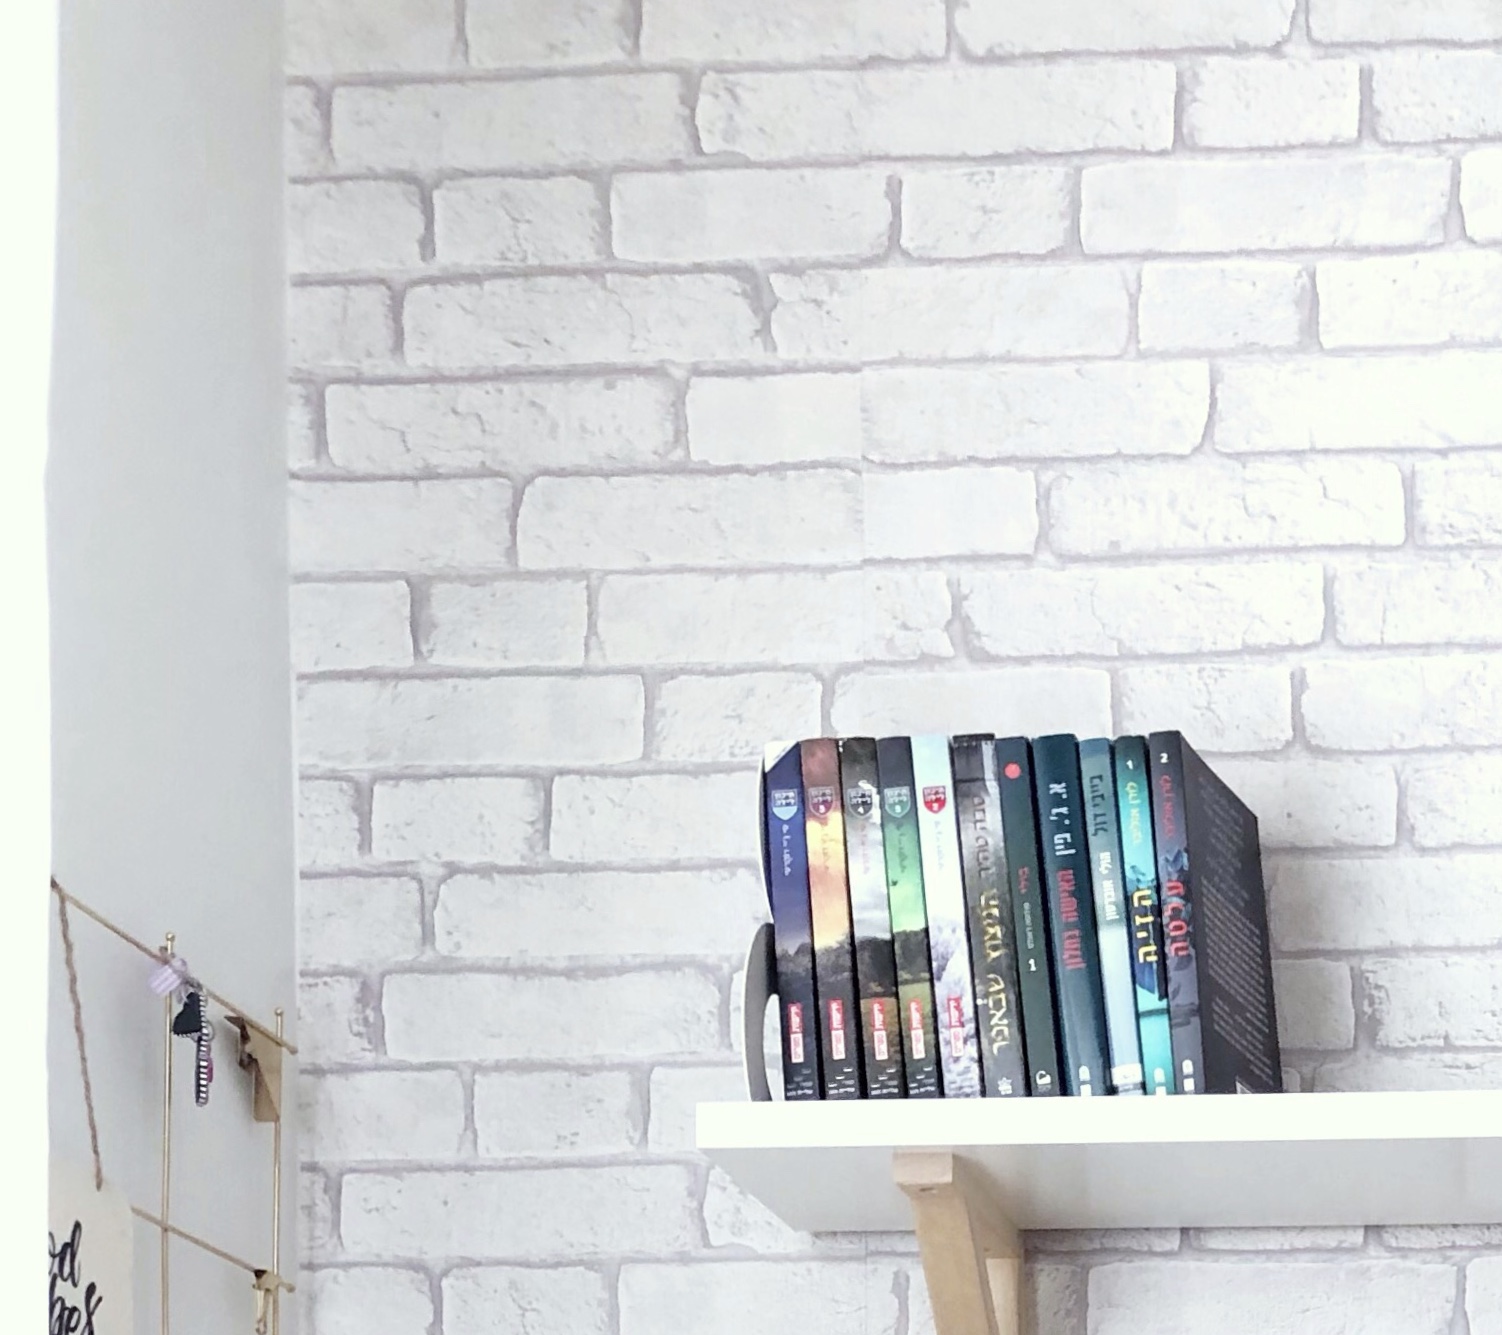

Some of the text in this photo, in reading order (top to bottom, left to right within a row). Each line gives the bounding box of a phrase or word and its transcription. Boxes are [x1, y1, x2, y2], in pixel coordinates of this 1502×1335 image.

[1160, 752, 1169, 763] 2
[1053, 833, 1077, 856] פין
[1092, 813, 1108, 837] דול
[1057, 870, 1087, 970] האישה בחלון
[1133, 888, 1158, 963] הזיה
[1164, 879, 1190, 957] עלטה
